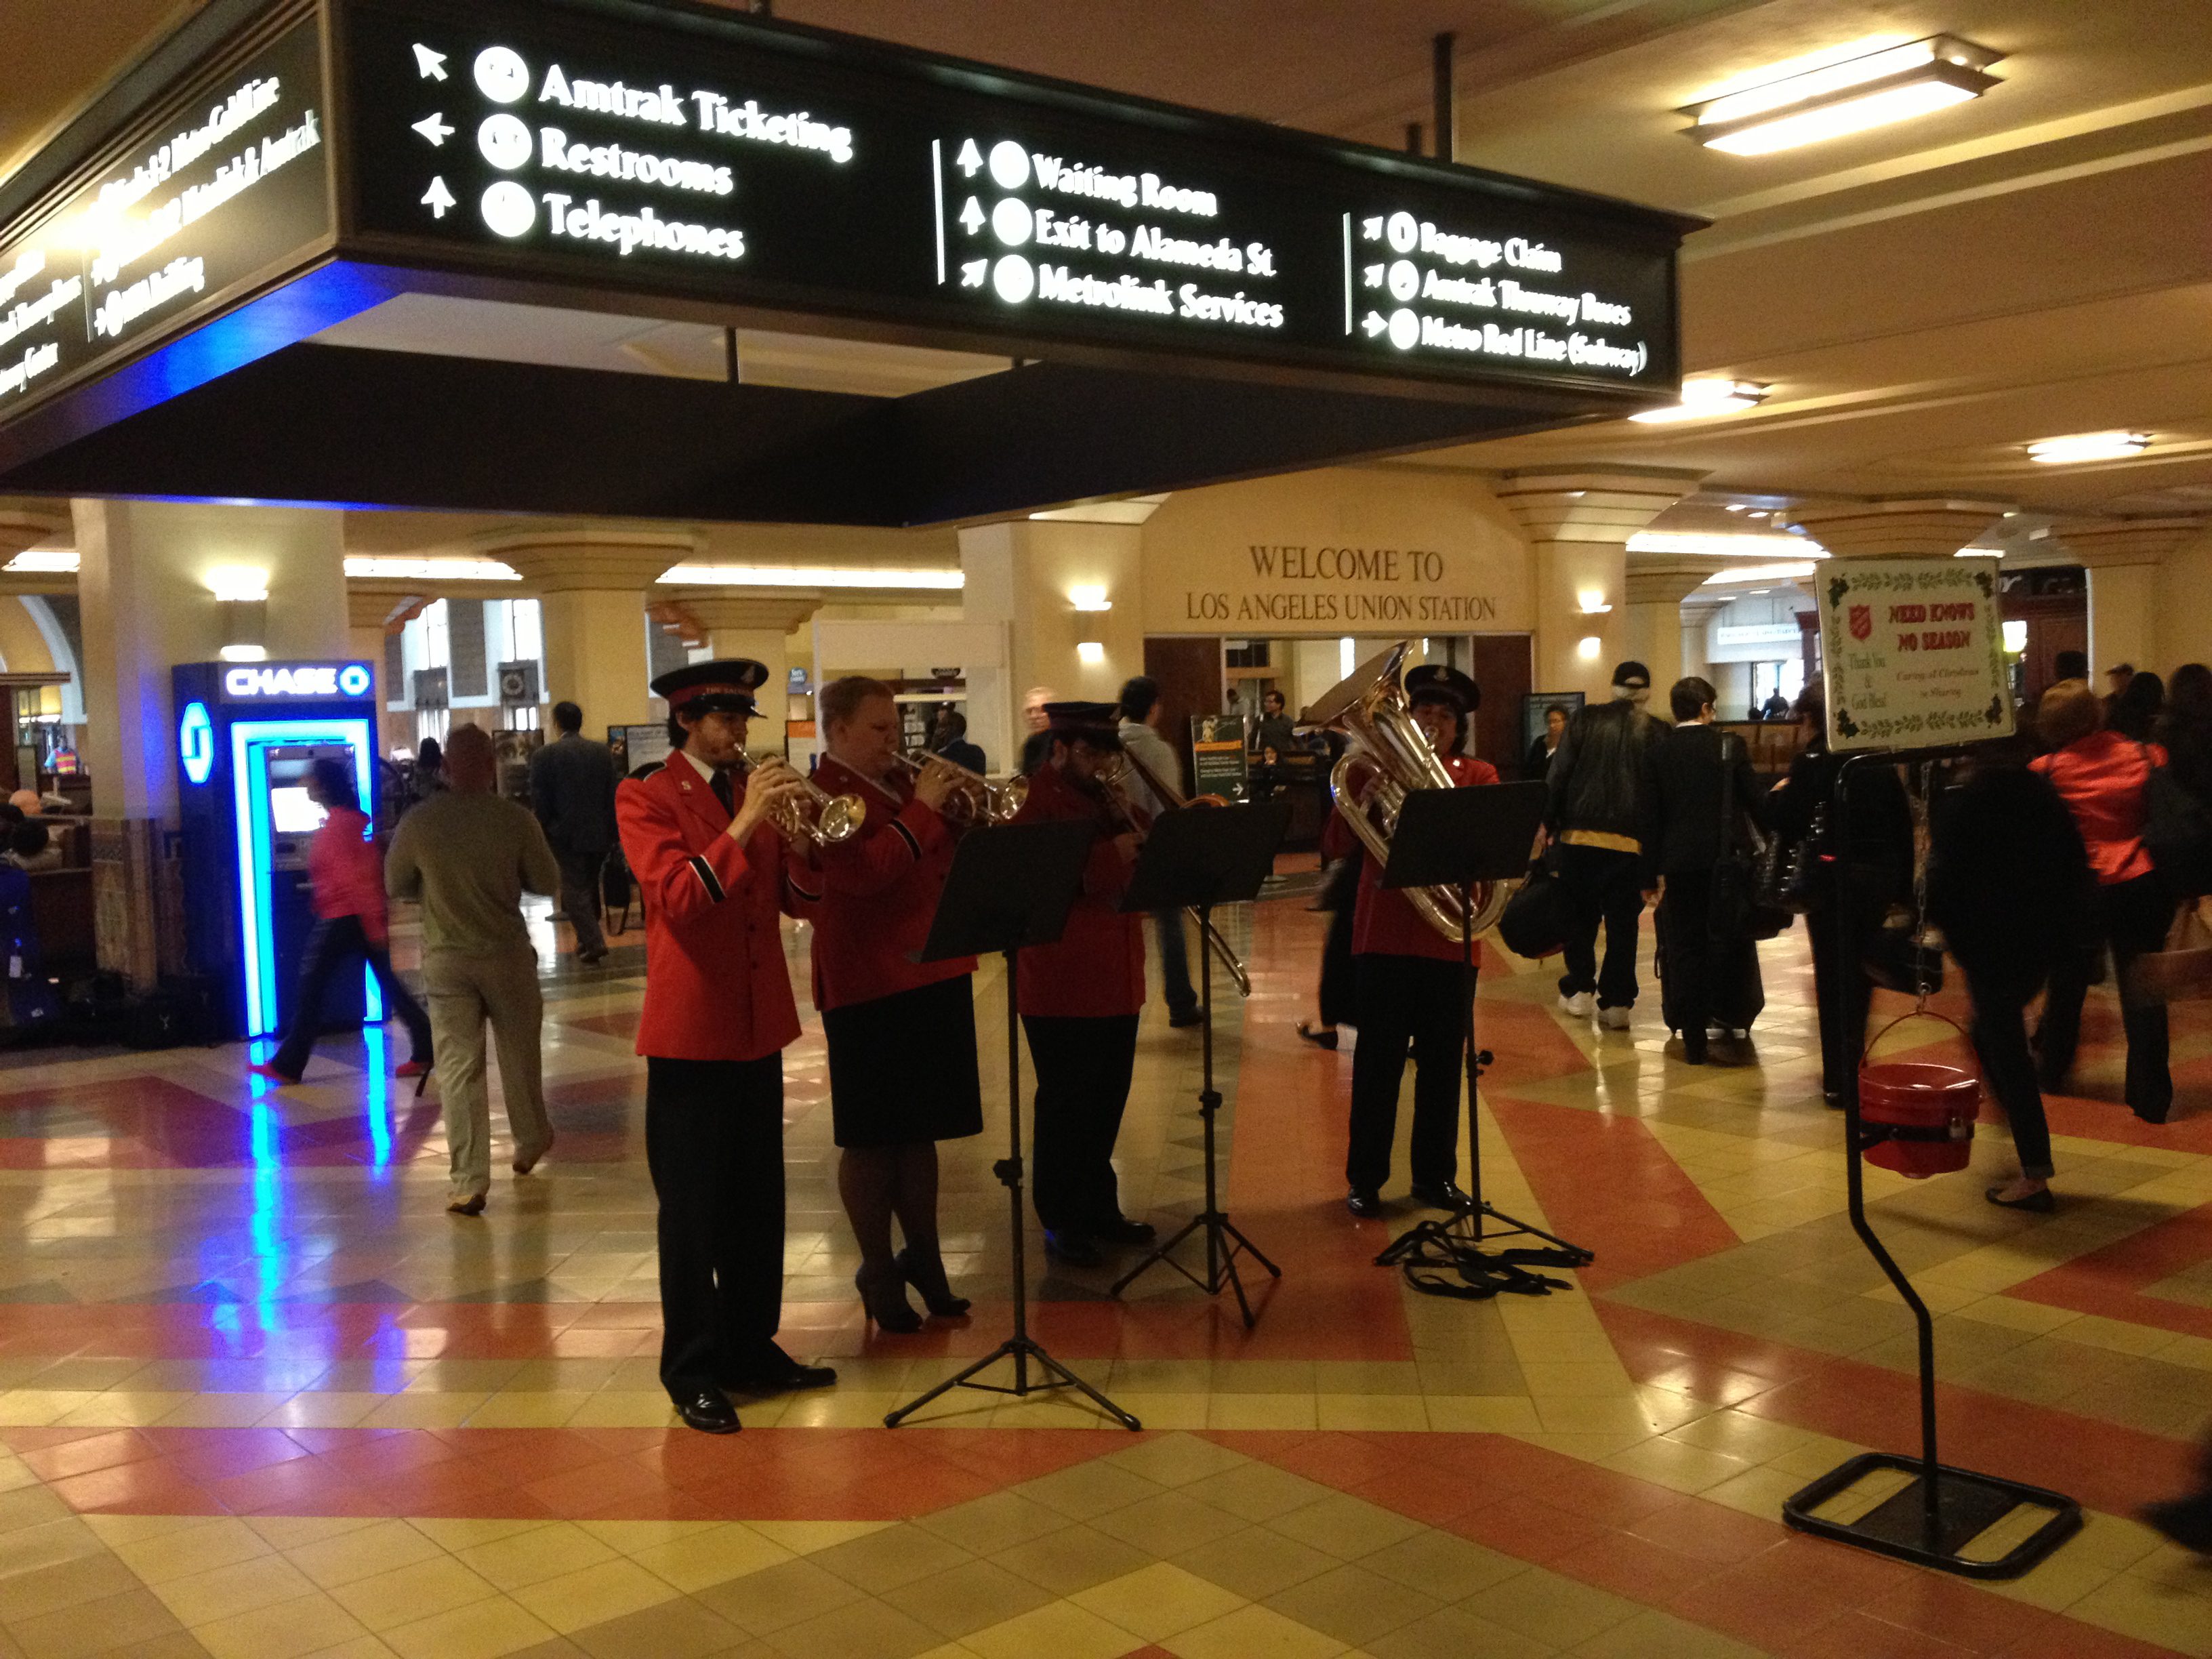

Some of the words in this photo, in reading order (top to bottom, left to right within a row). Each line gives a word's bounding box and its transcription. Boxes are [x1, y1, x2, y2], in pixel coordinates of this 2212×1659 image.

[260, 109, 321, 178] Amtrak
[539, 64, 687, 126] Amtrak
[691, 90, 853, 163] Ticketing
[539, 127, 733, 194] Restrooms
[1031, 153, 1138, 208] Waiting
[1141, 173, 1218, 217] Room
[542, 193, 745, 259] Telephones
[1035, 209, 1092, 250] Exit
[1096, 224, 1126, 254] to
[1130, 225, 1243, 272] Alameda
[1420, 222, 1502, 268] Baggage
[1504, 237, 1562, 272] Claim
[1038, 264, 1175, 314] Metrolink
[1179, 284, 1284, 328] Services
[1421, 268, 1497, 307] Amtrak
[1498, 280, 1580, 326] Thruway
[1581, 293, 1632, 326] Buses
[1421, 316, 1482, 351] Metro
[1483, 323, 1523, 356] Red
[1525, 329, 1567, 361] Line
[1568, 331, 1647, 377] (Subway)
[1248, 546, 1400, 580] WELCOME
[1408, 551, 1443, 581] TO
[1186, 592, 1229, 619] LOS
[1236, 593, 1338, 621] ANGELES
[1345, 595, 1414, 621] UNION
[1418, 596, 1496, 621] STATION
[1889, 605, 1927, 623] NEED
[1929, 602, 1975, 621] KNOWS
[1898, 633, 1918, 652] NO
[1922, 630, 1971, 651] SEASON
[226, 668, 338, 695] CHASE
